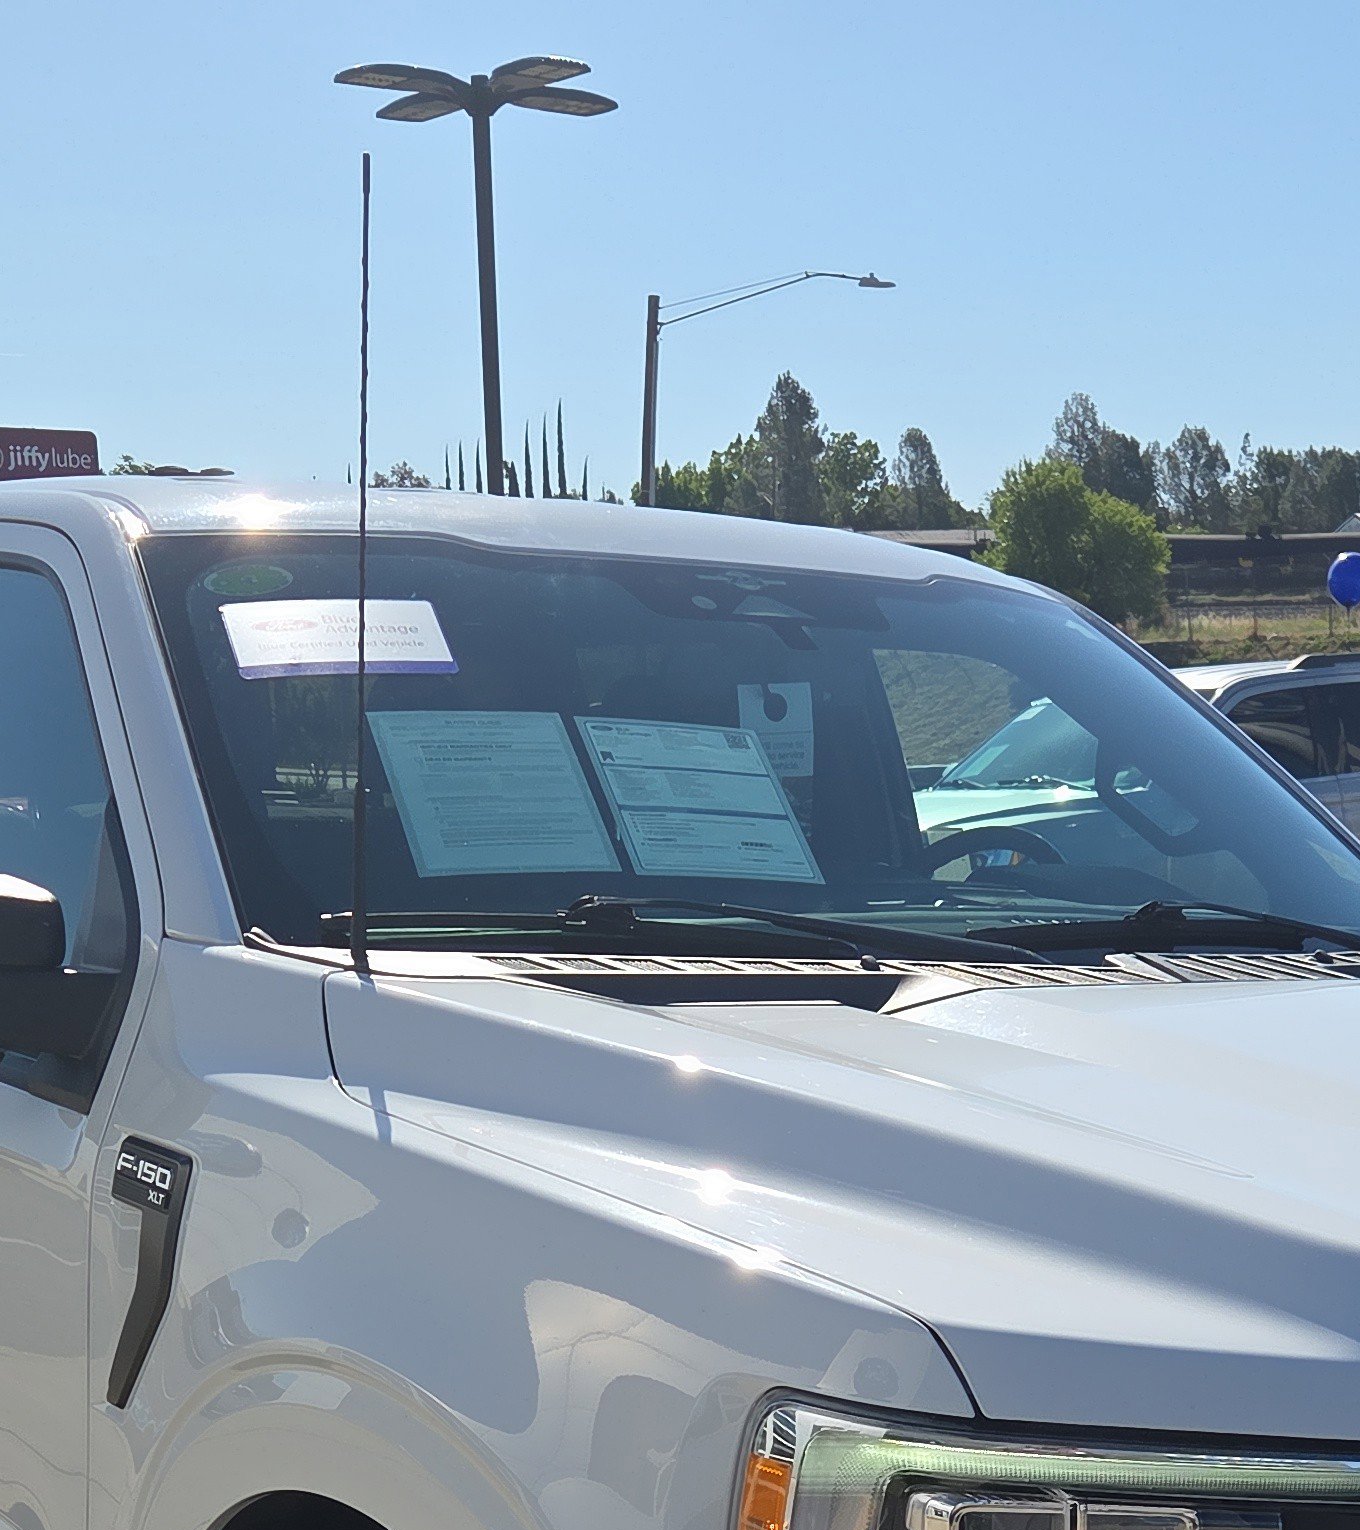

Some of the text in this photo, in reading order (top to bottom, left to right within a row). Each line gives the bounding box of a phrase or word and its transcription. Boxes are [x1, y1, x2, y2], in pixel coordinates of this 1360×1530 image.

[7, 444, 92, 472] jiffy lube
[325, 624, 419, 635] Advntage
[346, 640, 378, 649] Ued
[116, 1152, 171, 1190] F-150
[147, 1189, 165, 1205] XLT
